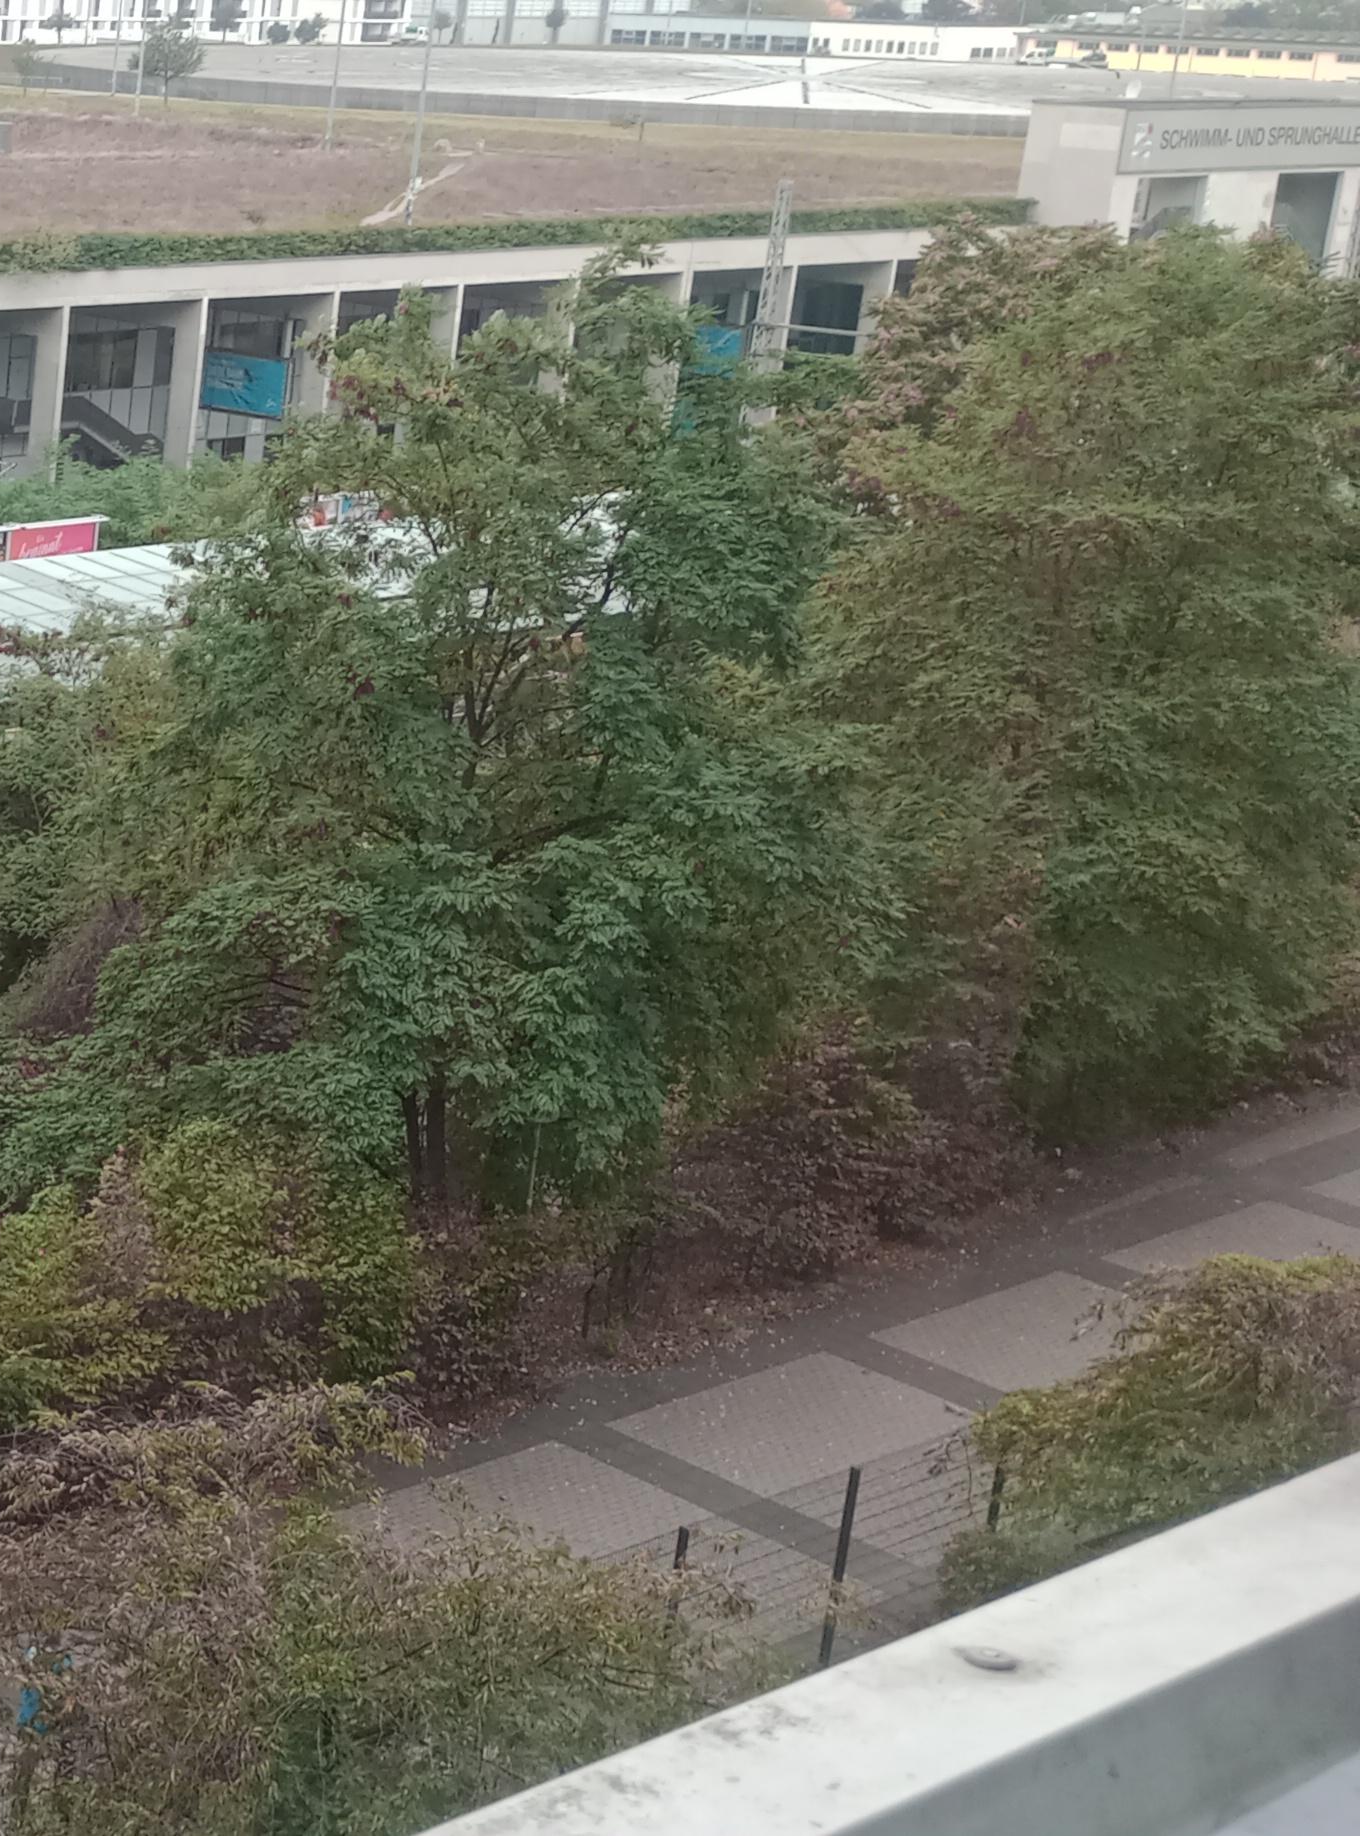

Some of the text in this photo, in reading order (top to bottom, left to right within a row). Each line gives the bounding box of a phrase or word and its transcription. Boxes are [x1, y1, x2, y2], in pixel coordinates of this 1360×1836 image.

[1160, 125, 1360, 150] SCHWIMM- UND SPRUNGHALLE
